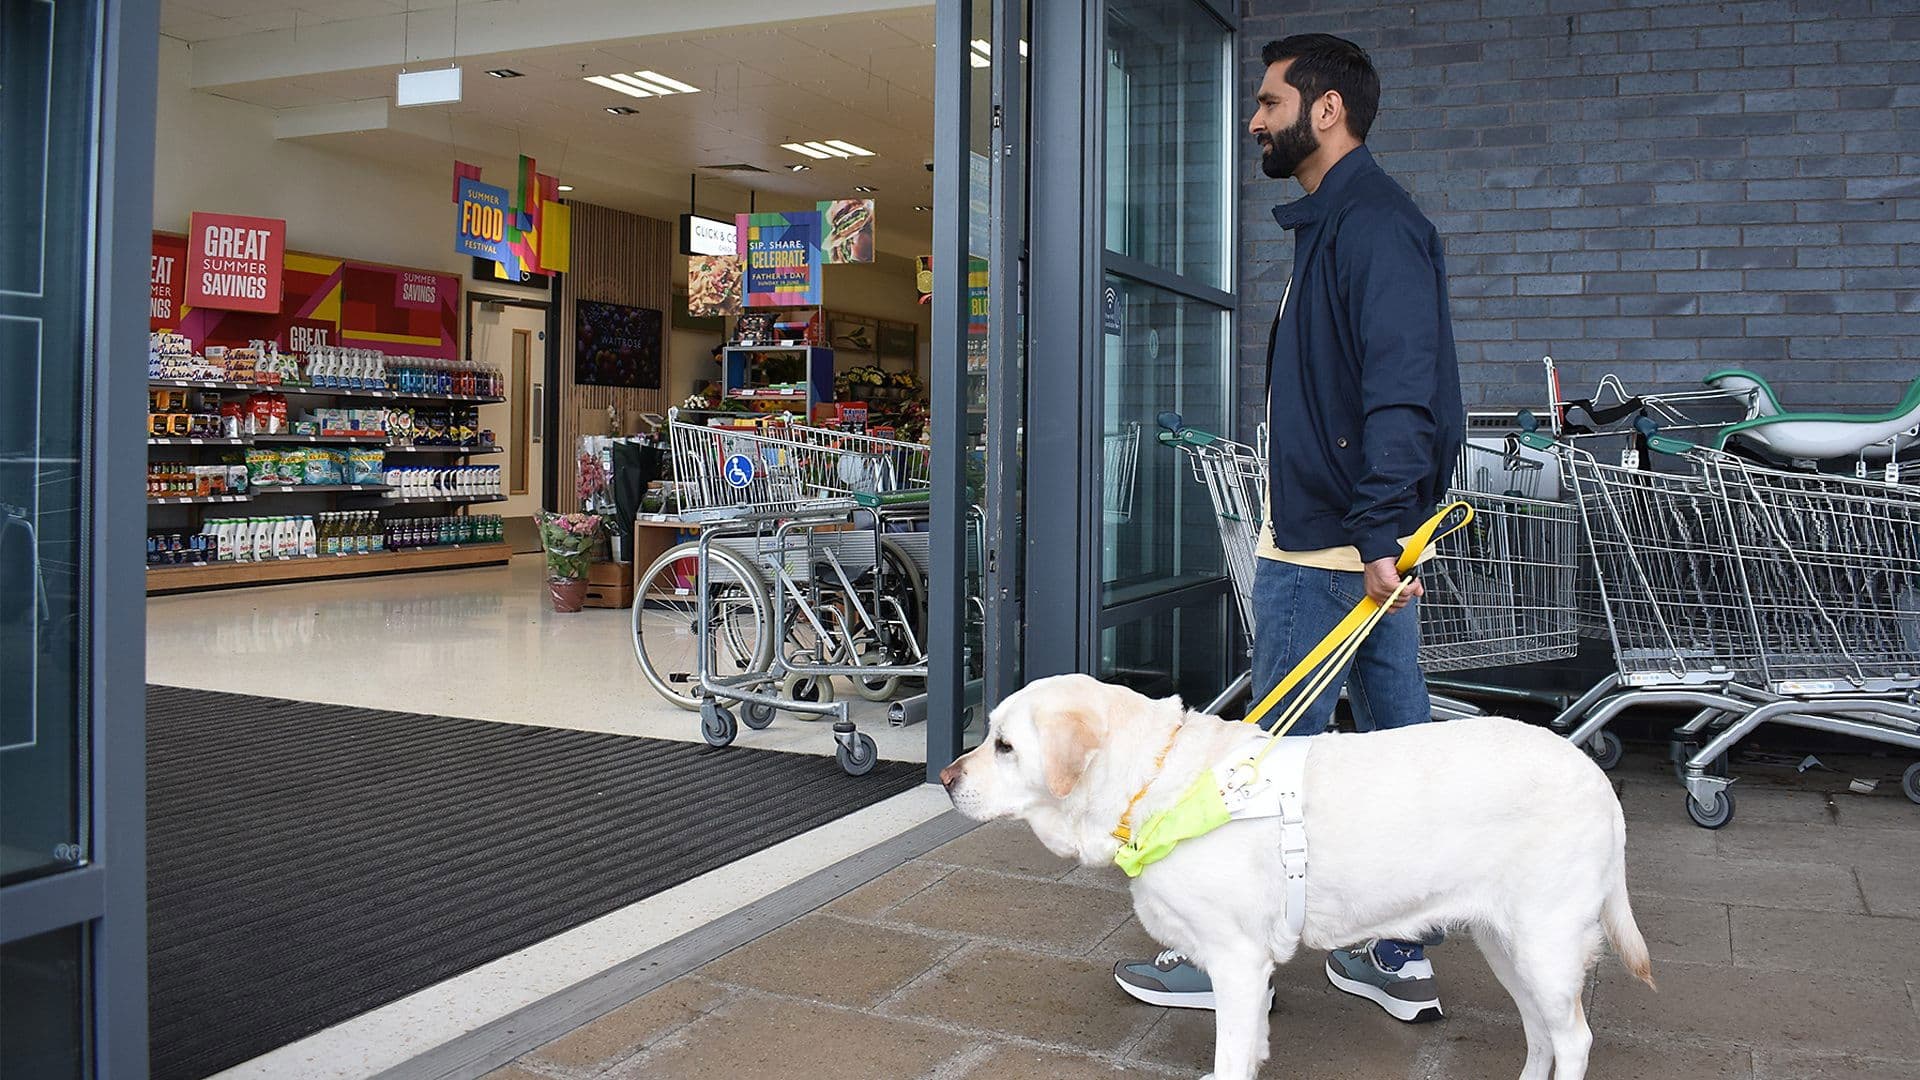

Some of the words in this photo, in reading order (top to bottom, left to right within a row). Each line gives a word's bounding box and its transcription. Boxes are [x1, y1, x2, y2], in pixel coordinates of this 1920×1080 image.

[468, 189, 500, 206] SUMMER
[461, 200, 504, 243] FOOD
[695, 226, 718, 240] CLICK
[719, 232, 725, 241] &
[204, 225, 271, 261] GREAT
[464, 240, 497, 254] FESTIVAL
[749, 240, 767, 250] SIP.
[769, 240, 805, 249] SHARE.
[203, 258, 267, 275] SUMMER
[752, 250, 808, 268] CELEBRATE.
[202, 272, 267, 300] SAVINGS
[403, 272, 437, 286] SUMMER
[402, 282, 436, 304] SAVINGS
[290, 326, 328, 352] GREAT
[601, 335, 642, 349] WAITROSE
